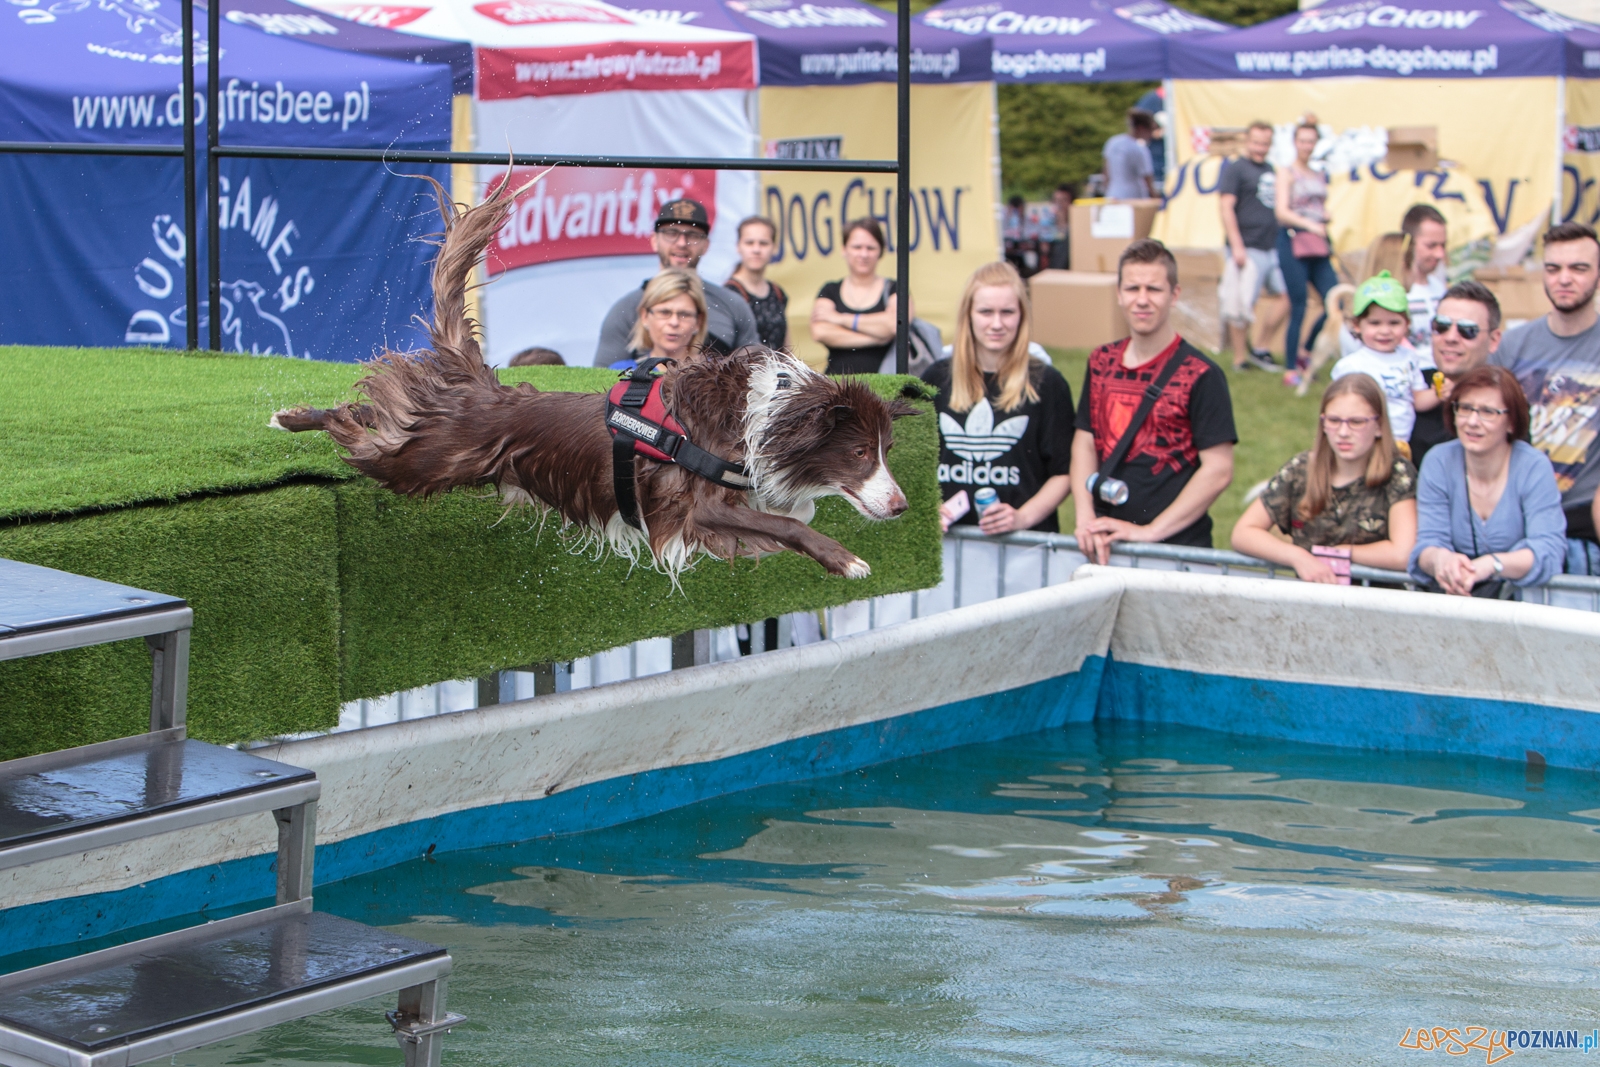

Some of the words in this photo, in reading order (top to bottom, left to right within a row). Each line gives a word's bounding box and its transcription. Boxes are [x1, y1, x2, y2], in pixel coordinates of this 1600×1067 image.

[985, 10, 1097, 35] CHOW
[1366, 5, 1487, 29] CHOW
[1233, 43, 1499, 77] www.purina-dogchow.pl
[766, 185, 833, 264] DOG
[611, 410, 658, 441] BORDERPOWER
[937, 460, 1021, 486] adidas
